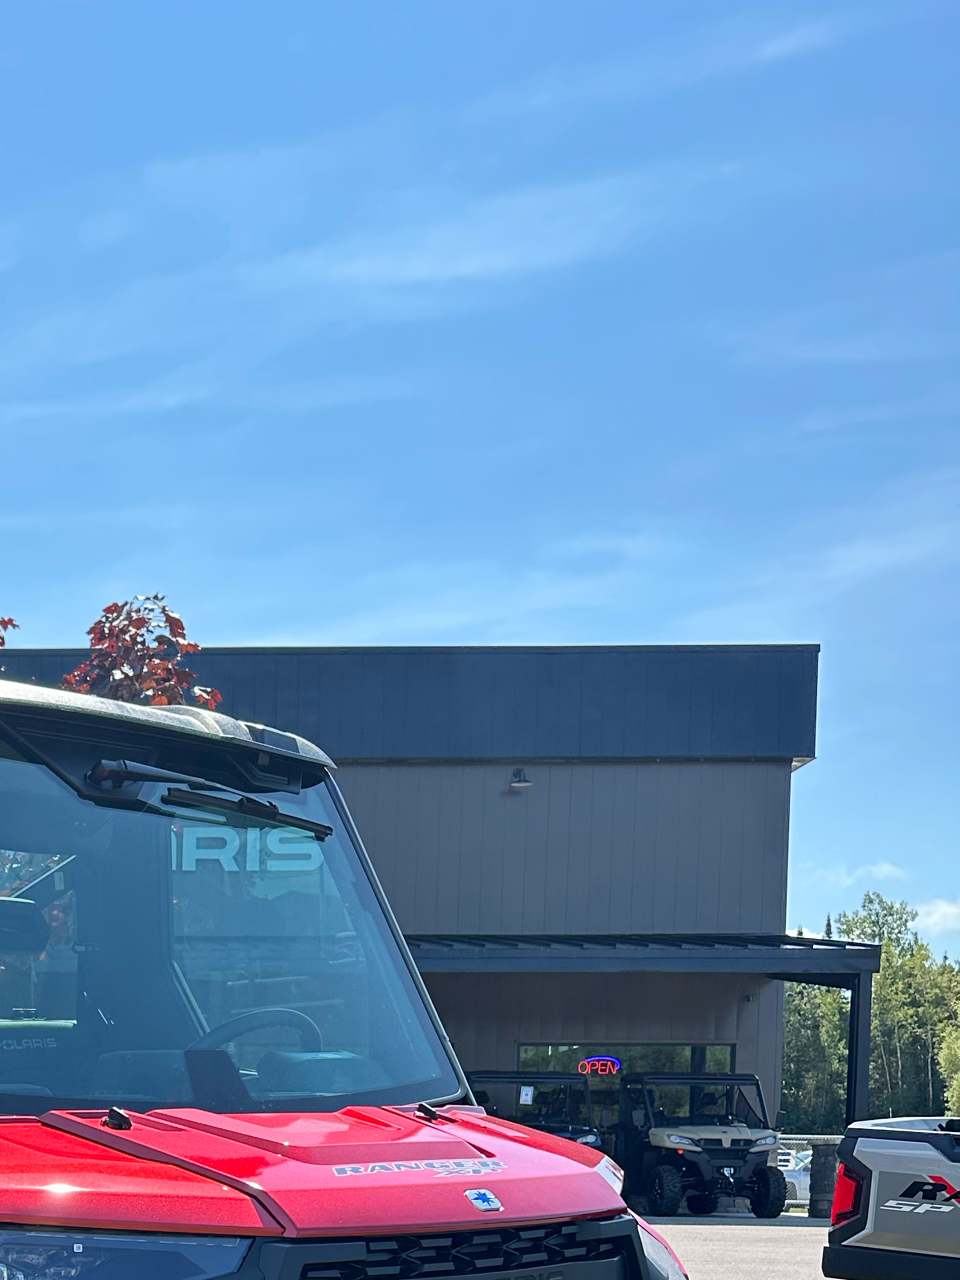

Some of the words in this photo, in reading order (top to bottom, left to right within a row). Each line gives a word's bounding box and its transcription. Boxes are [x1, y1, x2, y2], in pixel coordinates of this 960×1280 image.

[577, 1060, 617, 1075] OPEN
[333, 1161, 508, 1177] RANGER
[431, 1168, 503, 1178] XP
[879, 1199, 955, 1214] SP
